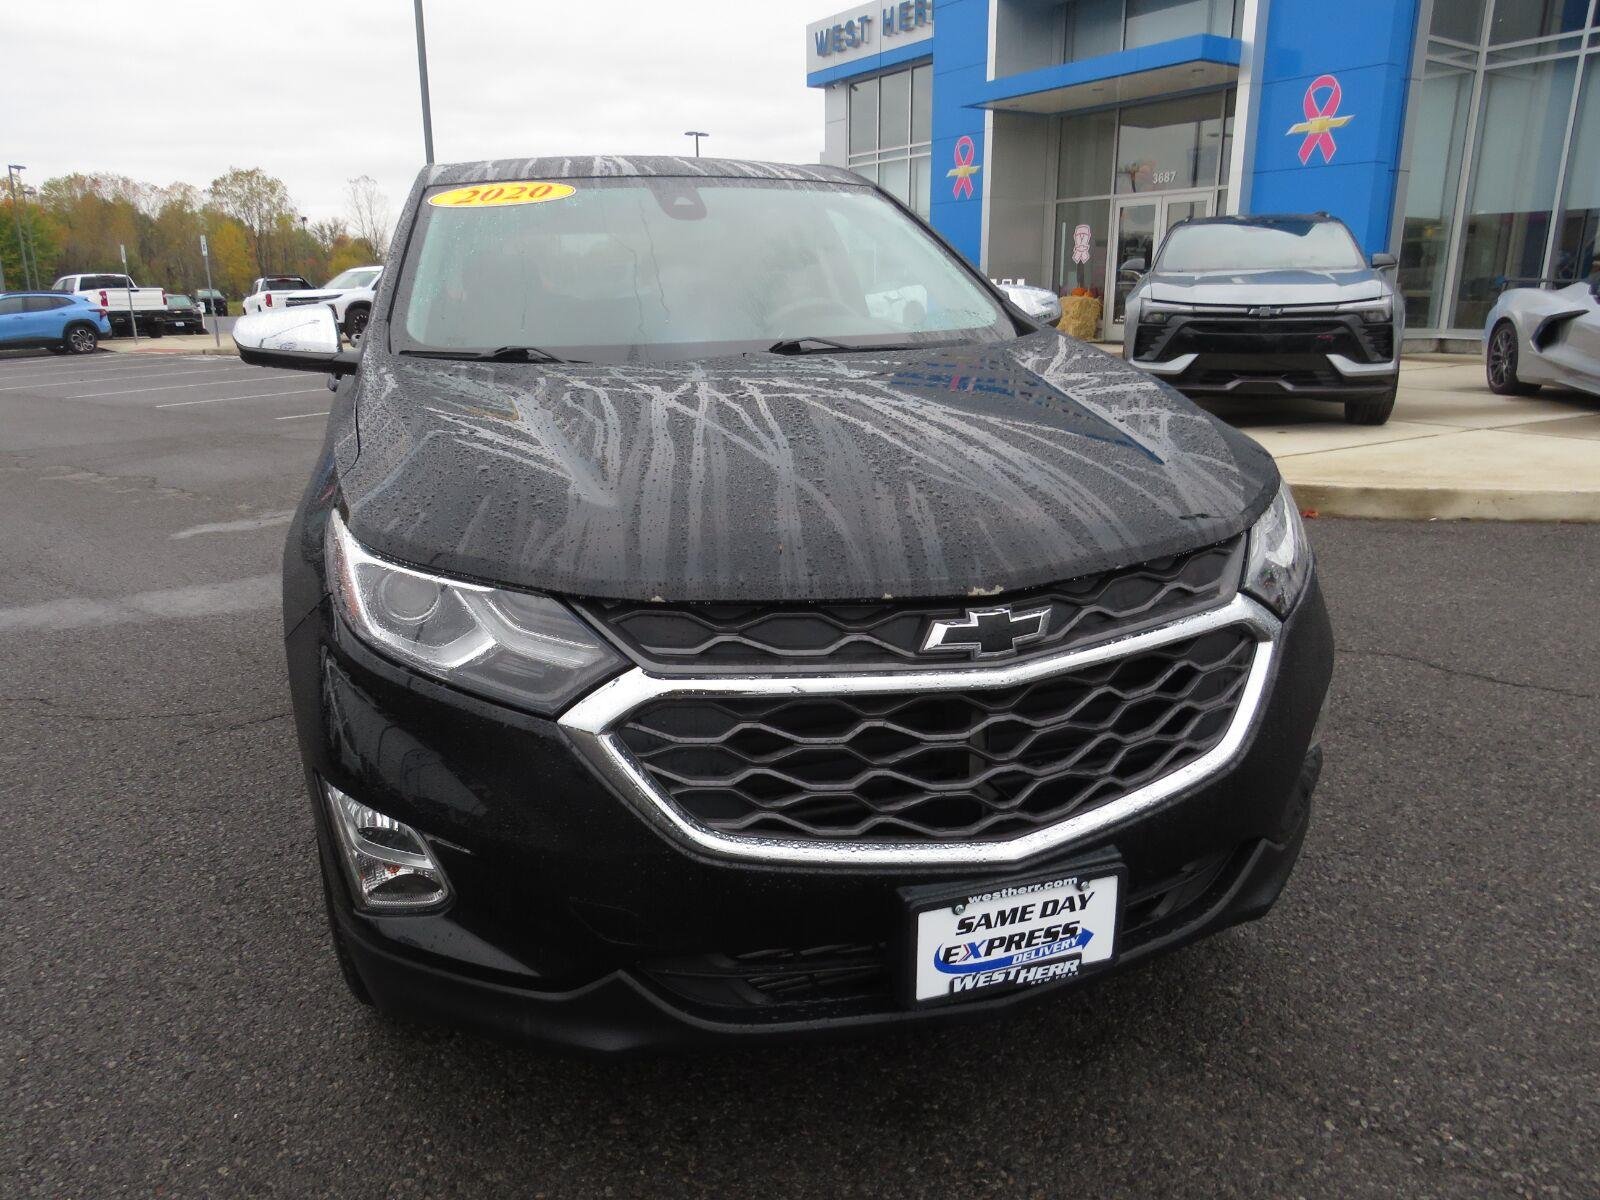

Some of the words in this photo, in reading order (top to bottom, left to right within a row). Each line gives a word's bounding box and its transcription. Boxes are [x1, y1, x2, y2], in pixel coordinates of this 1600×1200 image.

[814, 15, 870, 57] WEST
[882, 0, 933, 36] HER
[1152, 171, 1177, 184] 3687
[454, 185, 553, 204] 2020
[967, 877, 1078, 903] westherr.com
[956, 903, 1035, 935] SAME
[1039, 891, 1095, 918] DAY
[942, 920, 1080, 963] EXPRESS
[1011, 936, 1080, 965] DELIVERY
